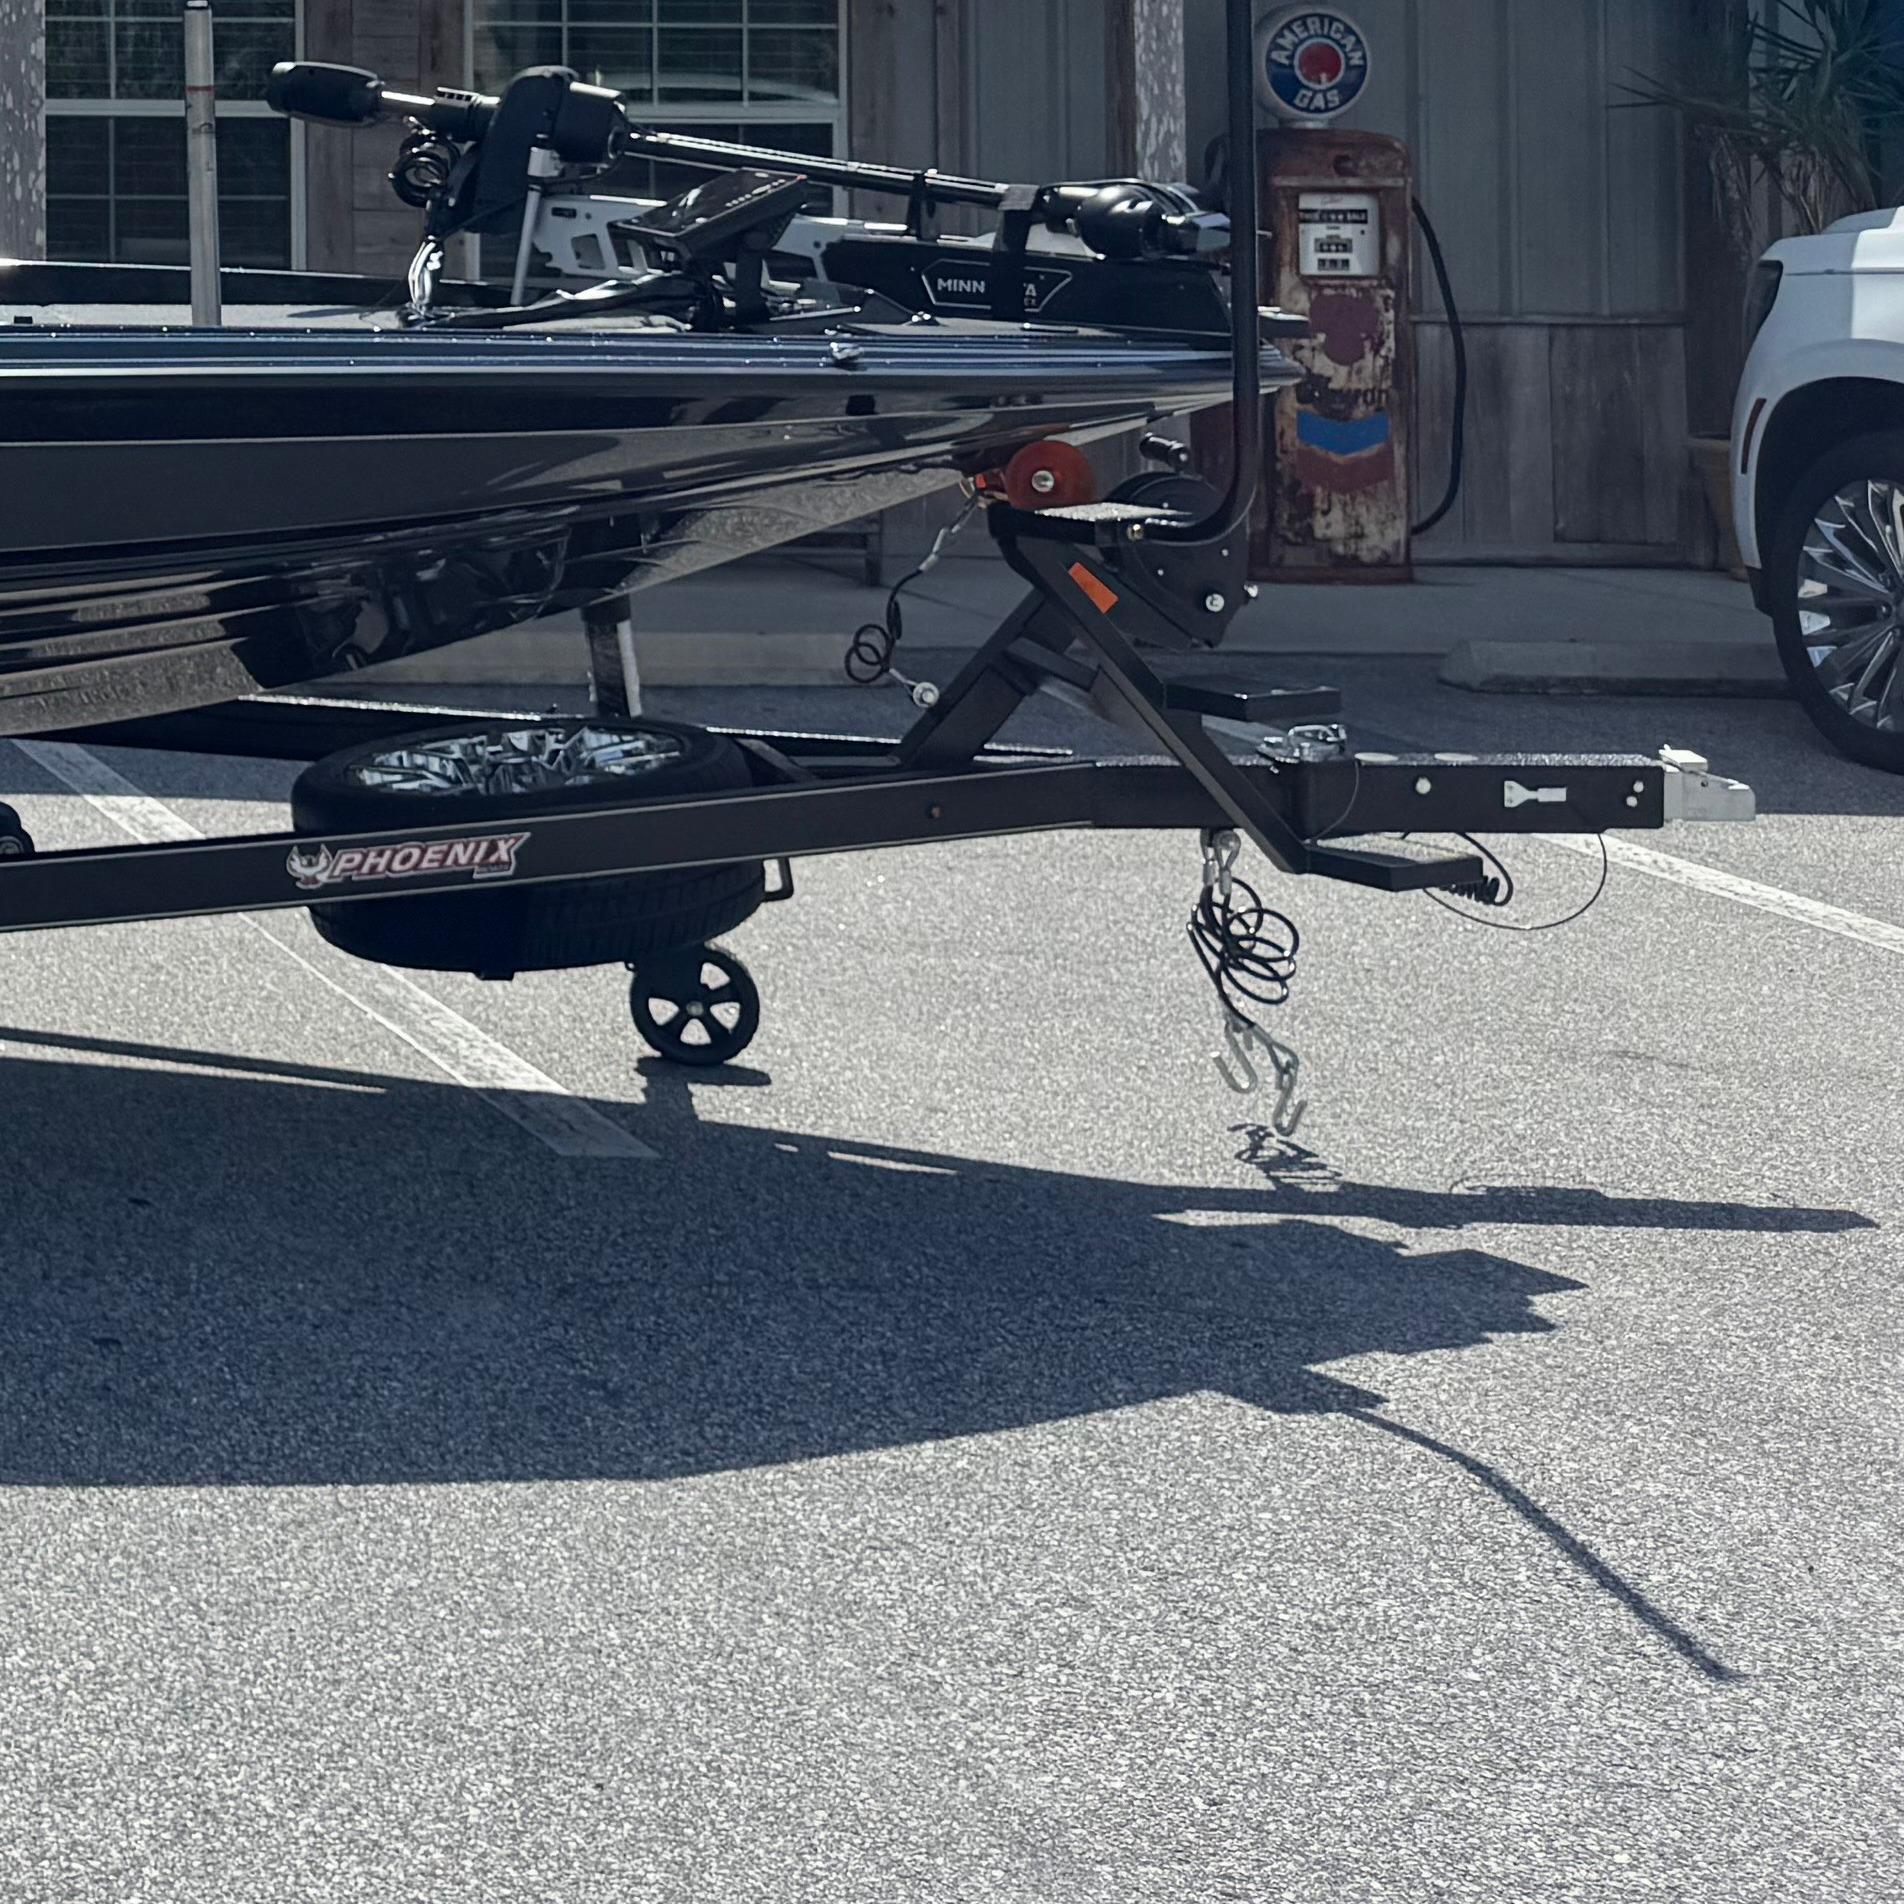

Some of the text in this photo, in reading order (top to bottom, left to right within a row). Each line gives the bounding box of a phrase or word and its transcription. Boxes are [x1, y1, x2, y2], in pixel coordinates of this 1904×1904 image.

[1271, 16, 1365, 66] AMERICAN
[1294, 89, 1340, 110] GAS
[937, 278, 985, 294] MINN
[332, 836, 520, 876] PHOENIX
